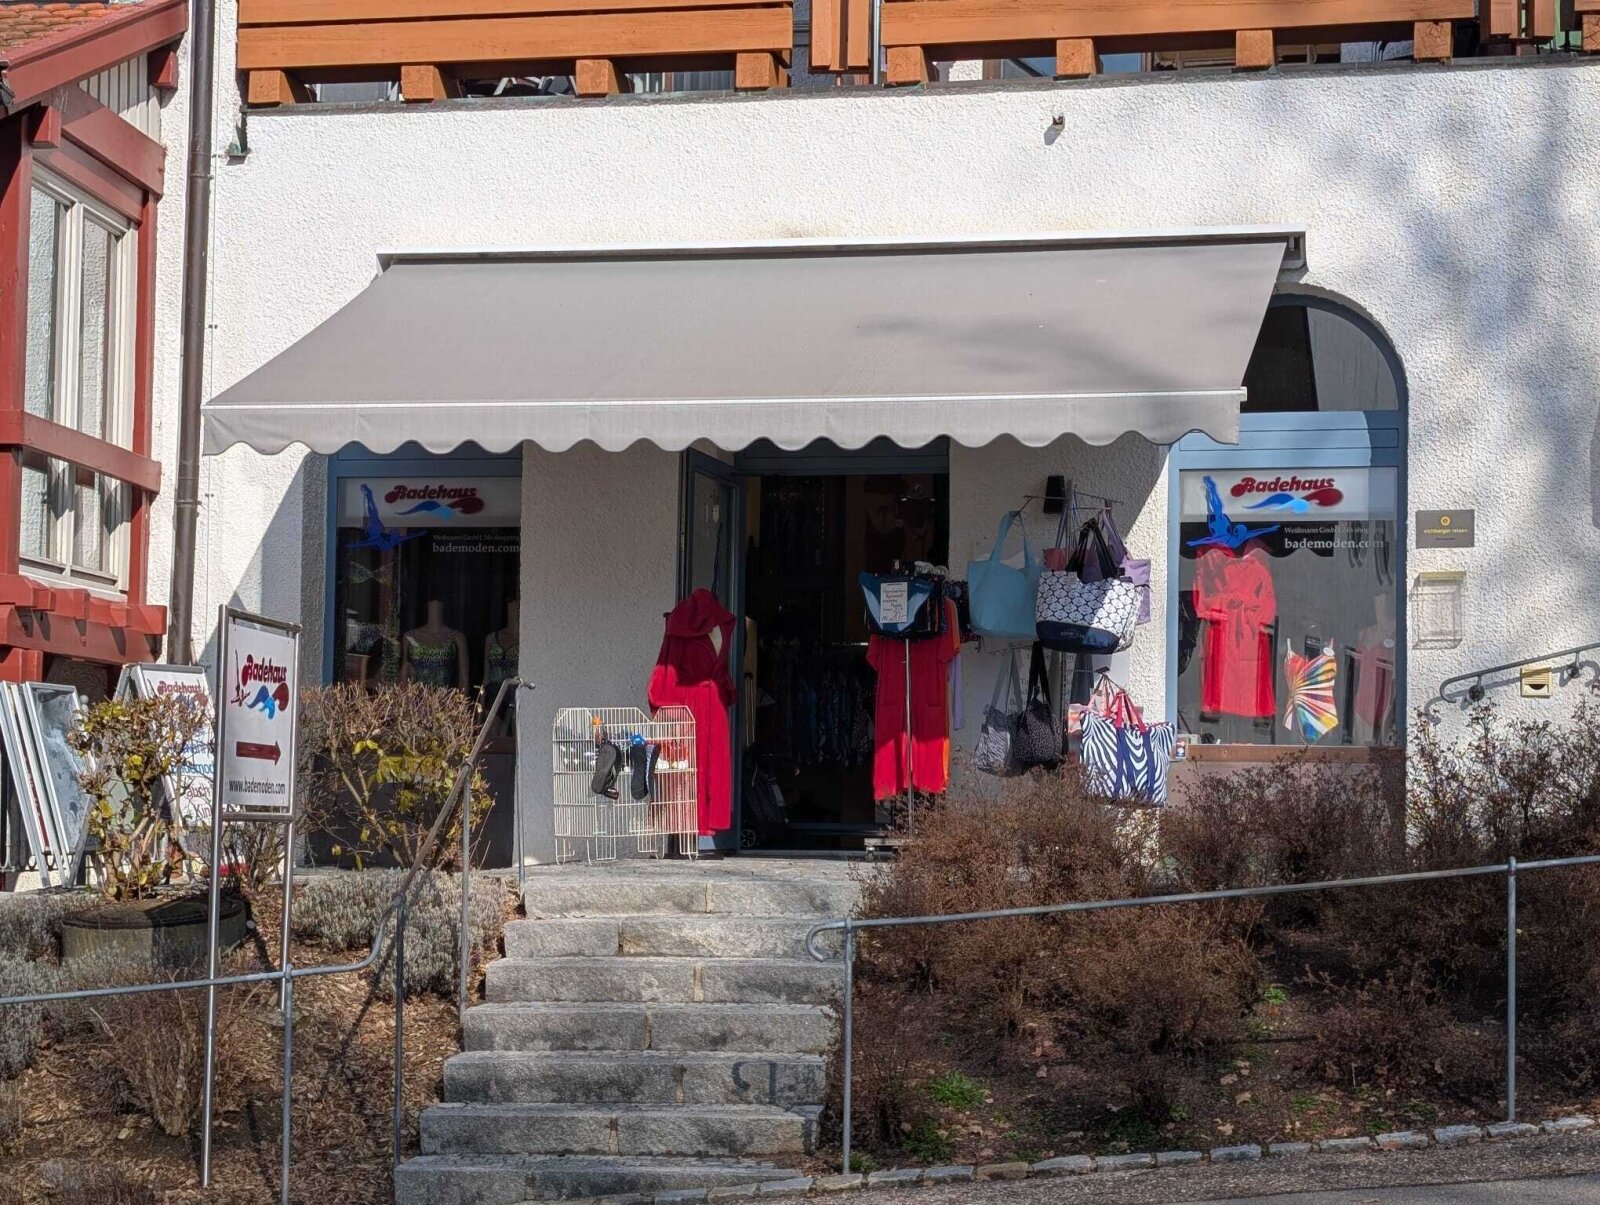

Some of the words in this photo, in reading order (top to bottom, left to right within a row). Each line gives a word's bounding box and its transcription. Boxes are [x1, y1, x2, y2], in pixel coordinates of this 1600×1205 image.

[384, 484, 477, 504] Badehaus
[1230, 475, 1335, 497] Badehaus
[432, 542, 520, 553] bademoden.com
[1284, 537, 1384, 549] bademoden.com
[242, 654, 287, 687] Badehaus
[157, 680, 204, 696] Badehaus
[228, 777, 286, 795] www.bademoden.com
